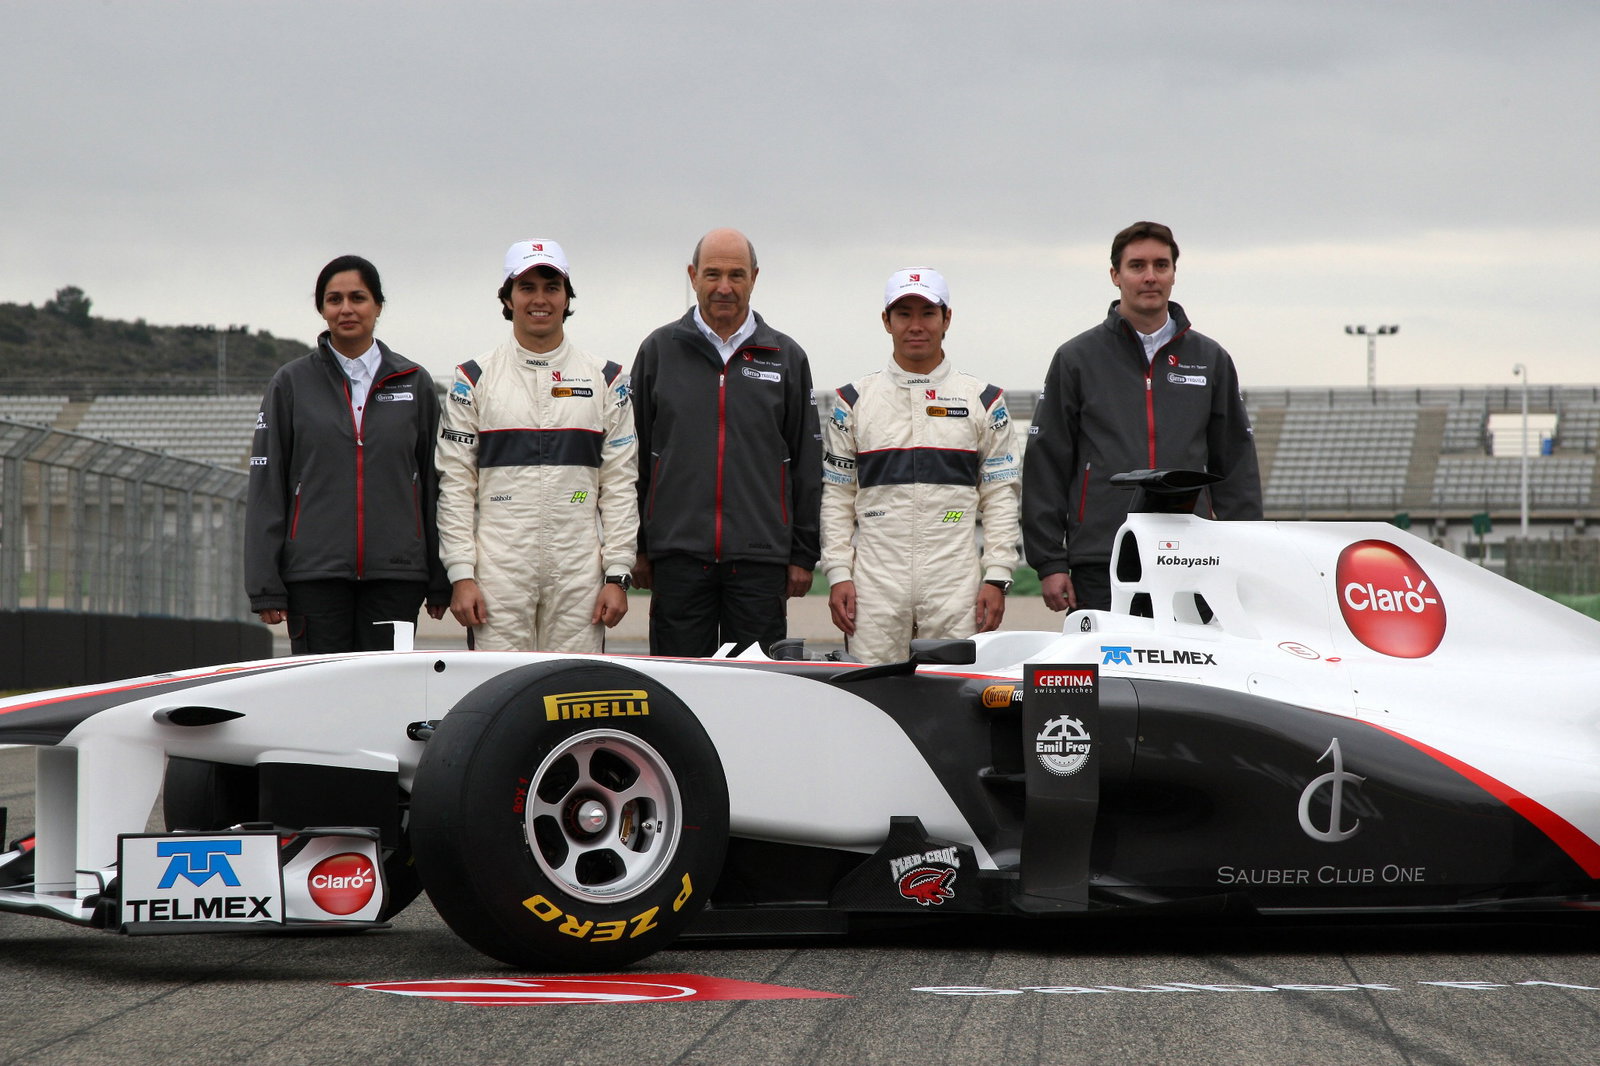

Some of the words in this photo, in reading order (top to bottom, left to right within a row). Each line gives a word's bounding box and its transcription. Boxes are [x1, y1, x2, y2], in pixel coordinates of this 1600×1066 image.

[1157, 556, 1219, 567] Kobayashi
[1134, 649, 1217, 665] TELMEX
[1039, 675, 1093, 687] CERTINA
[543, 690, 650, 721] PIRELLI
[1036, 741, 1063, 753] Emil
[1066, 741, 1091, 755] Frey
[672, 872, 693, 912] P
[126, 897, 272, 922] TELMEX
[522, 894, 660, 942] ZERO
